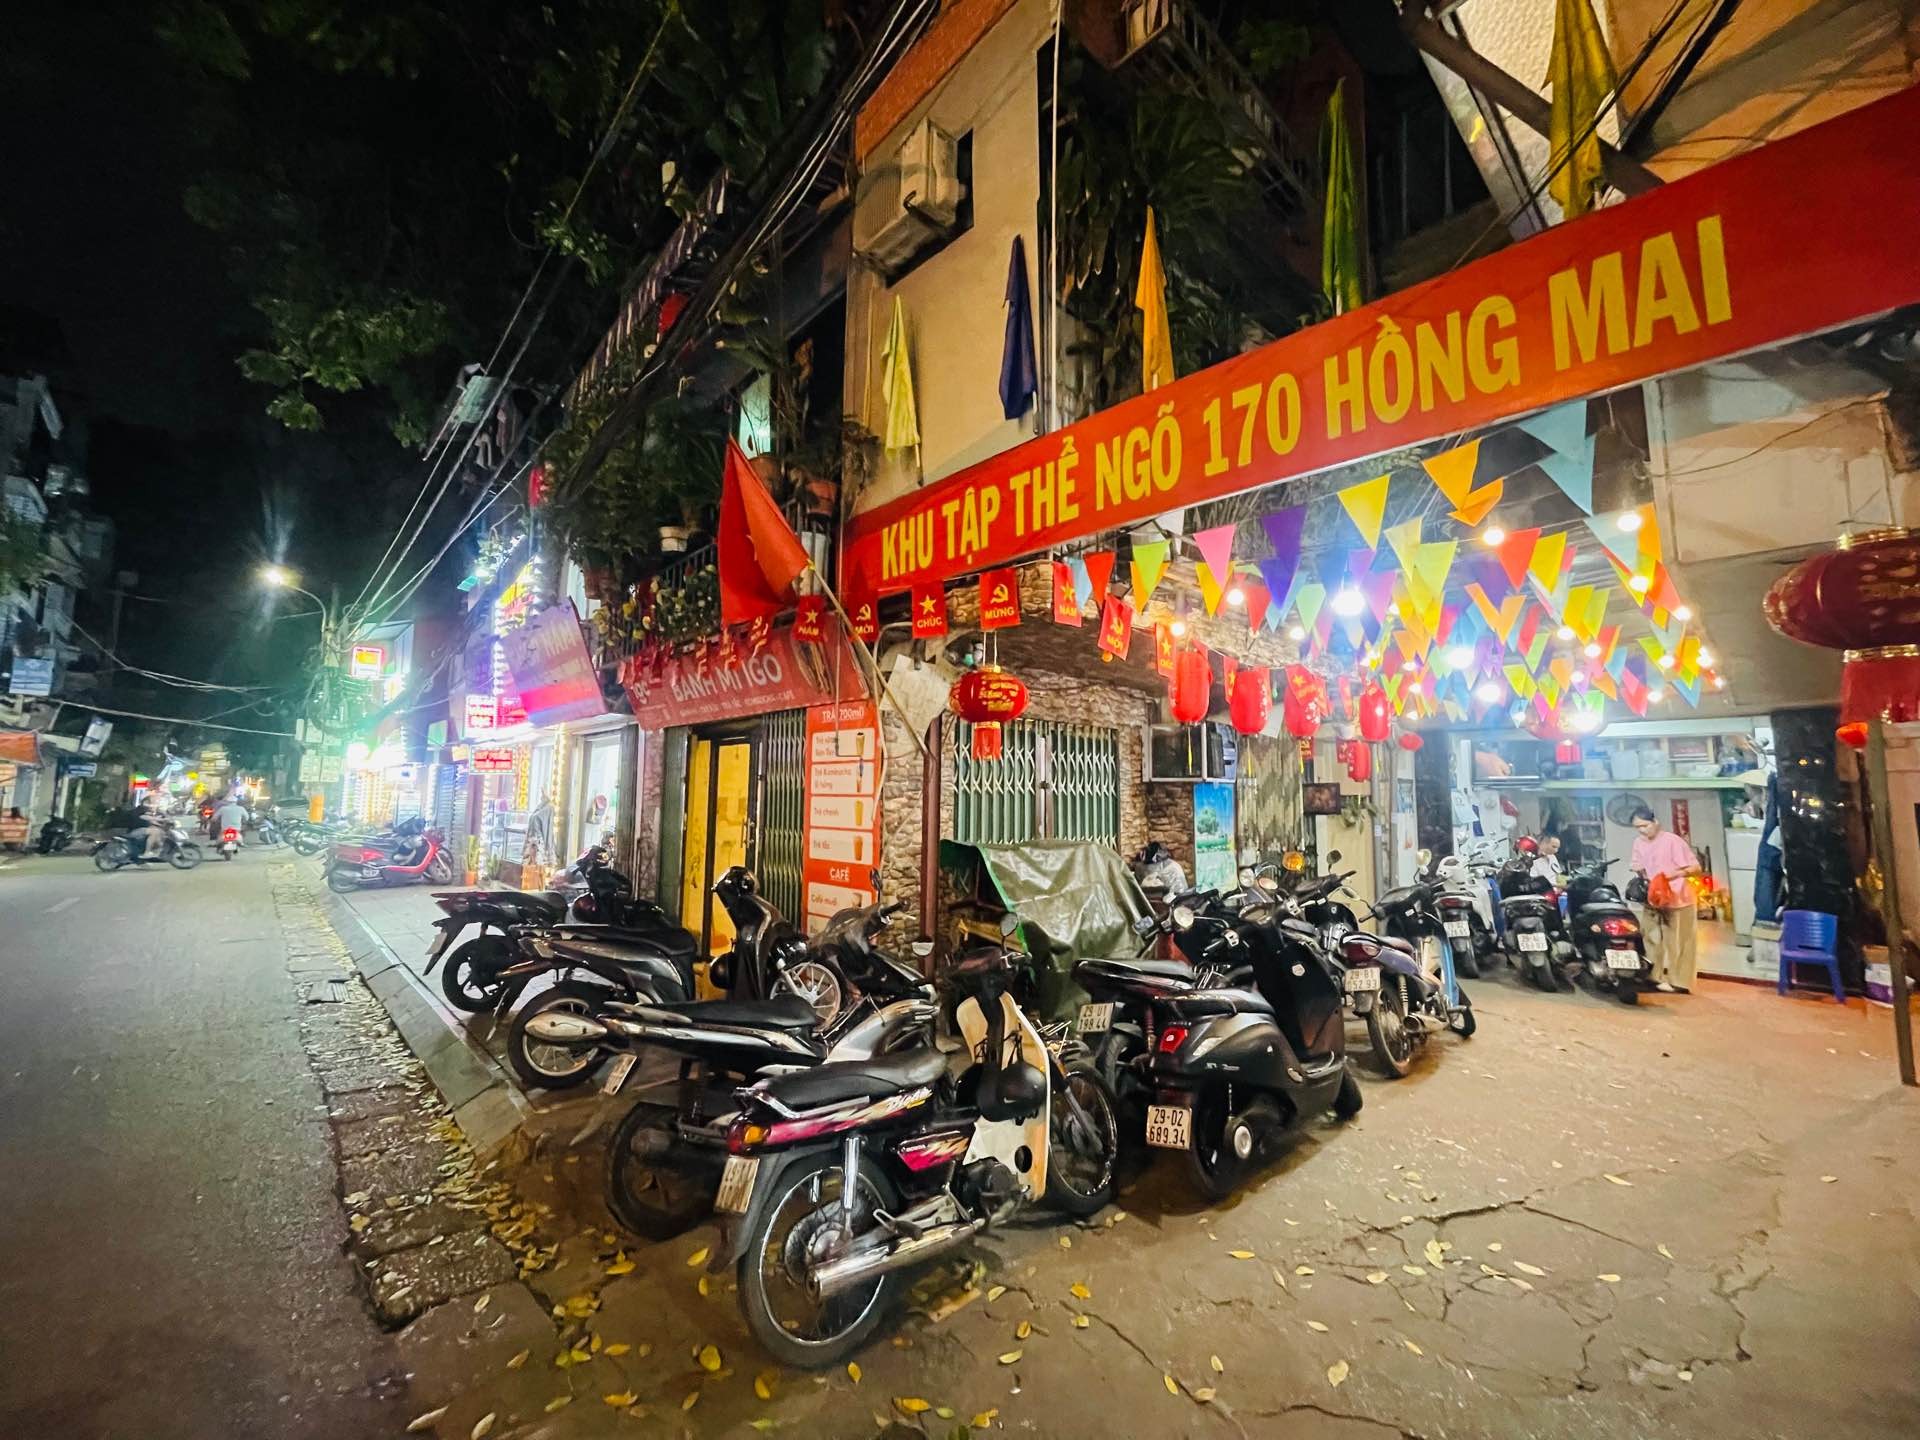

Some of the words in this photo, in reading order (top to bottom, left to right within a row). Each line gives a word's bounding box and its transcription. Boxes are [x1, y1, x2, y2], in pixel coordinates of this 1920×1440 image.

[882, 509, 934, 580] KHU
[942, 486, 1001, 565] TẬP
[1010, 435, 1080, 537] THỂ
[1095, 401, 1183, 511] NGÕ
[1202, 372, 1303, 477] 170
[1323, 315, 1522, 440] HỒNG
[1548, 214, 1733, 371] MAI
[984, 606, 1015, 619] MỪNG
[917, 616, 942, 628] CHÚC
[1149, 1126, 1186, 1147] 689.34
